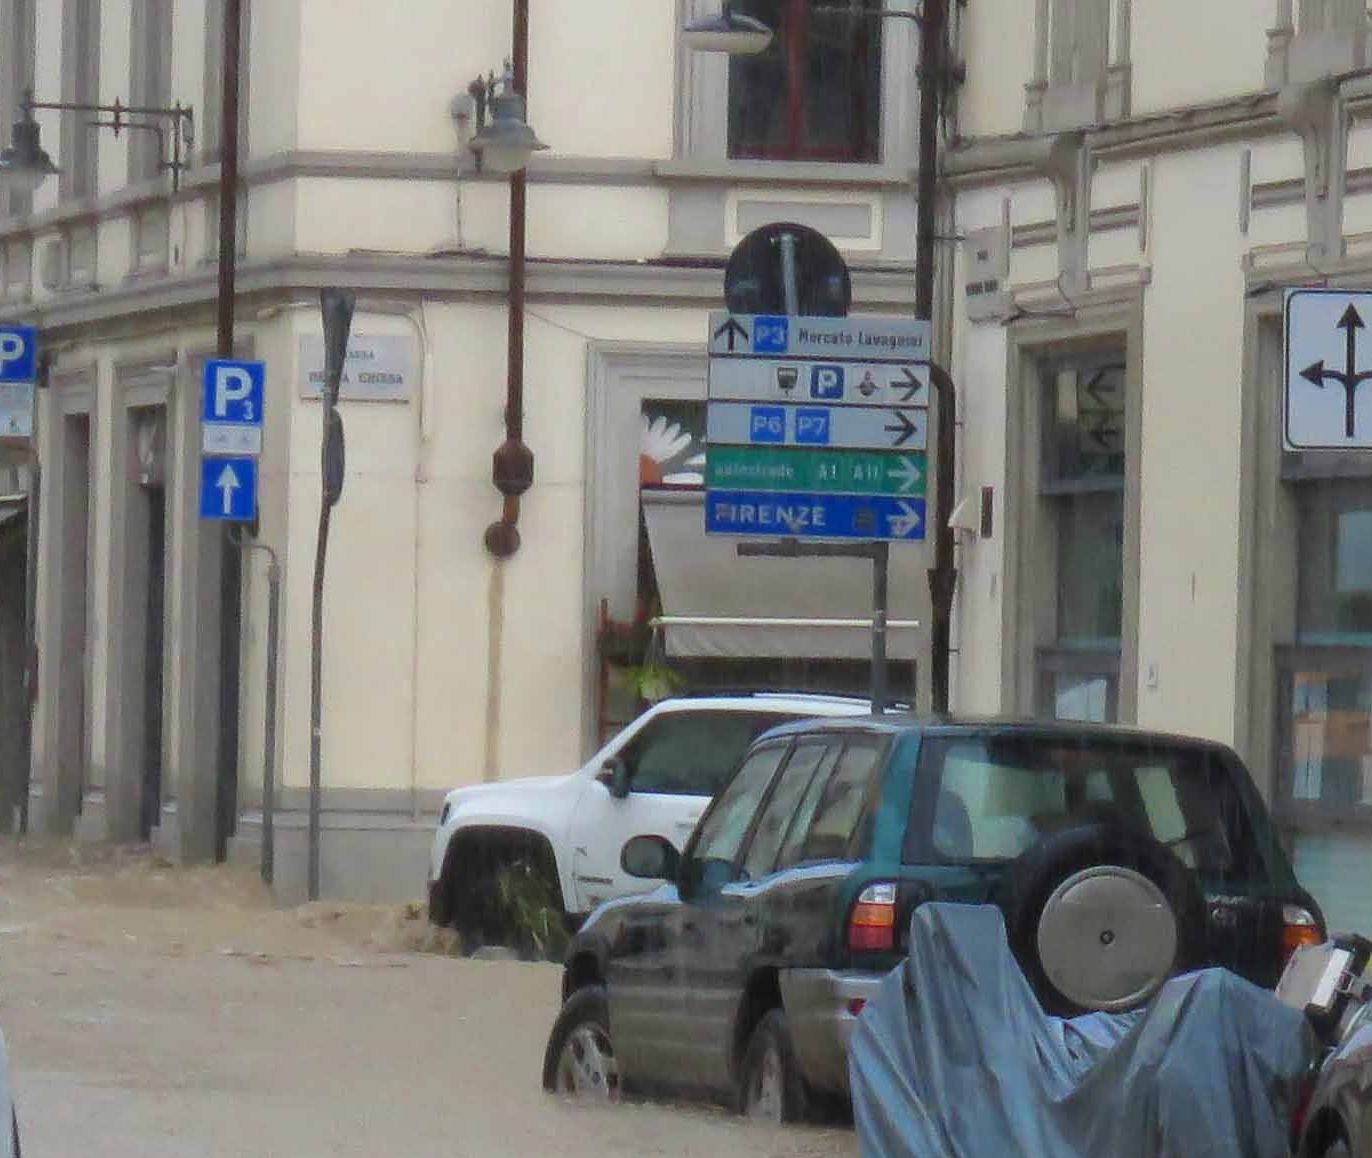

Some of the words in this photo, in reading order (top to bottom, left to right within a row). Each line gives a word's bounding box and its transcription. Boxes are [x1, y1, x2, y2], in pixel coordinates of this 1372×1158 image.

[758, 324, 786, 345] P3
[798, 328, 853, 346] Mercato
[817, 368, 838, 394] P
[753, 415, 781, 435] P6
[799, 416, 827, 437] P7
[818, 463, 837, 481] A1
[714, 504, 827, 527] FIRENZE
